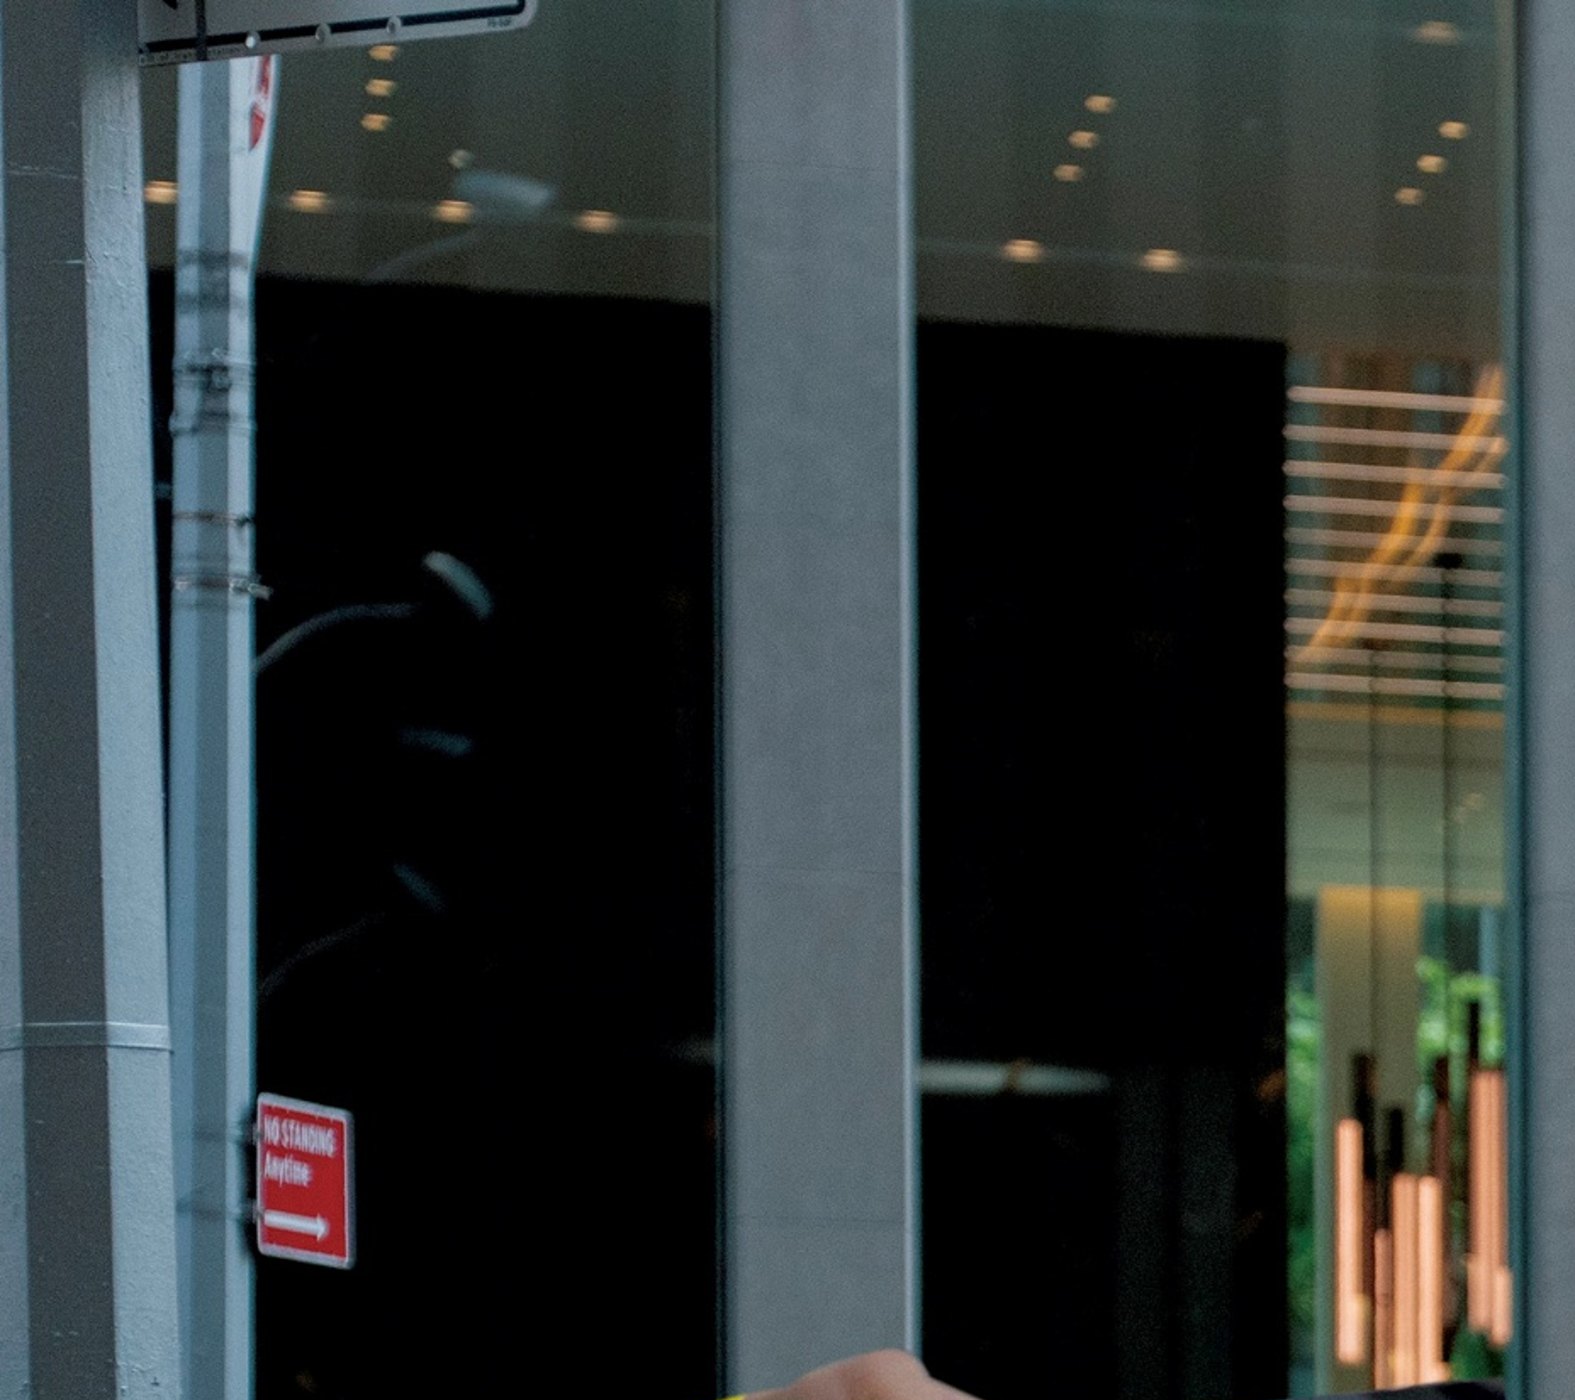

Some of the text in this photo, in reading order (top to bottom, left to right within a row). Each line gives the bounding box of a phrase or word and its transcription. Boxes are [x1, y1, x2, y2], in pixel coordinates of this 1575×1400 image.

[264, 1113, 335, 1158] NO STANDING
[264, 1150, 311, 1188] Anytime
